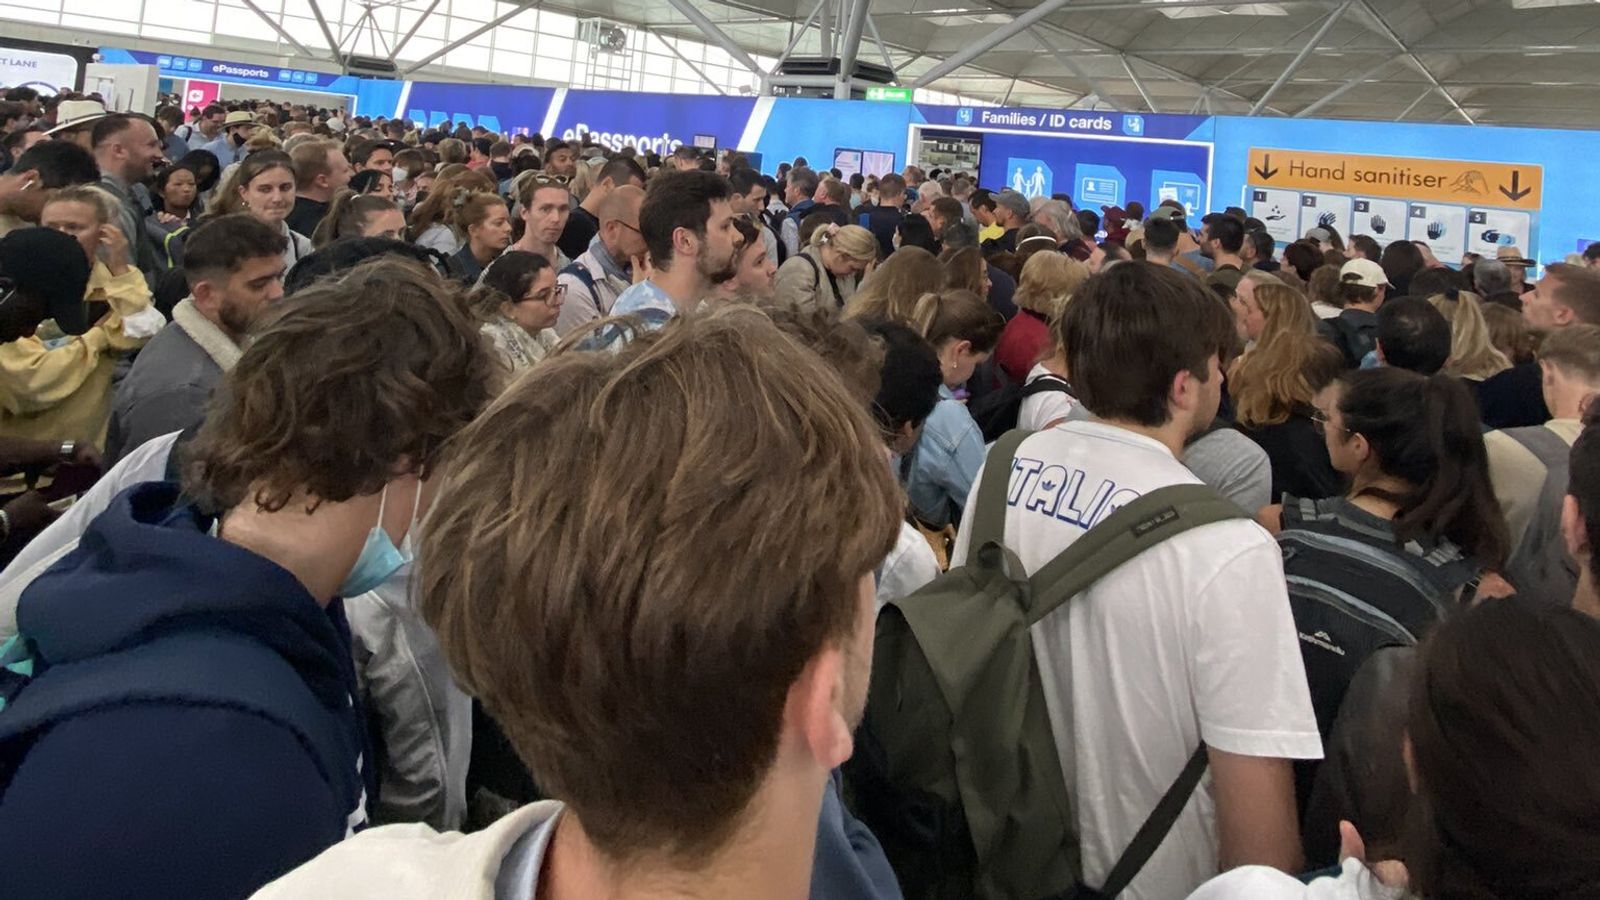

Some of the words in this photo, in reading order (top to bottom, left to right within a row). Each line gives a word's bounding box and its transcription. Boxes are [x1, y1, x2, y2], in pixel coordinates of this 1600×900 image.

[9, 59, 38, 69] LANE
[212, 63, 270, 79] ePassports
[981, 111, 1037, 126] Families
[1039, 113, 1047, 127] /
[1049, 114, 1066, 128] ID
[1068, 116, 1113, 131] cards
[1289, 159, 1346, 181] Hand
[1353, 167, 1448, 189] sanitiser
